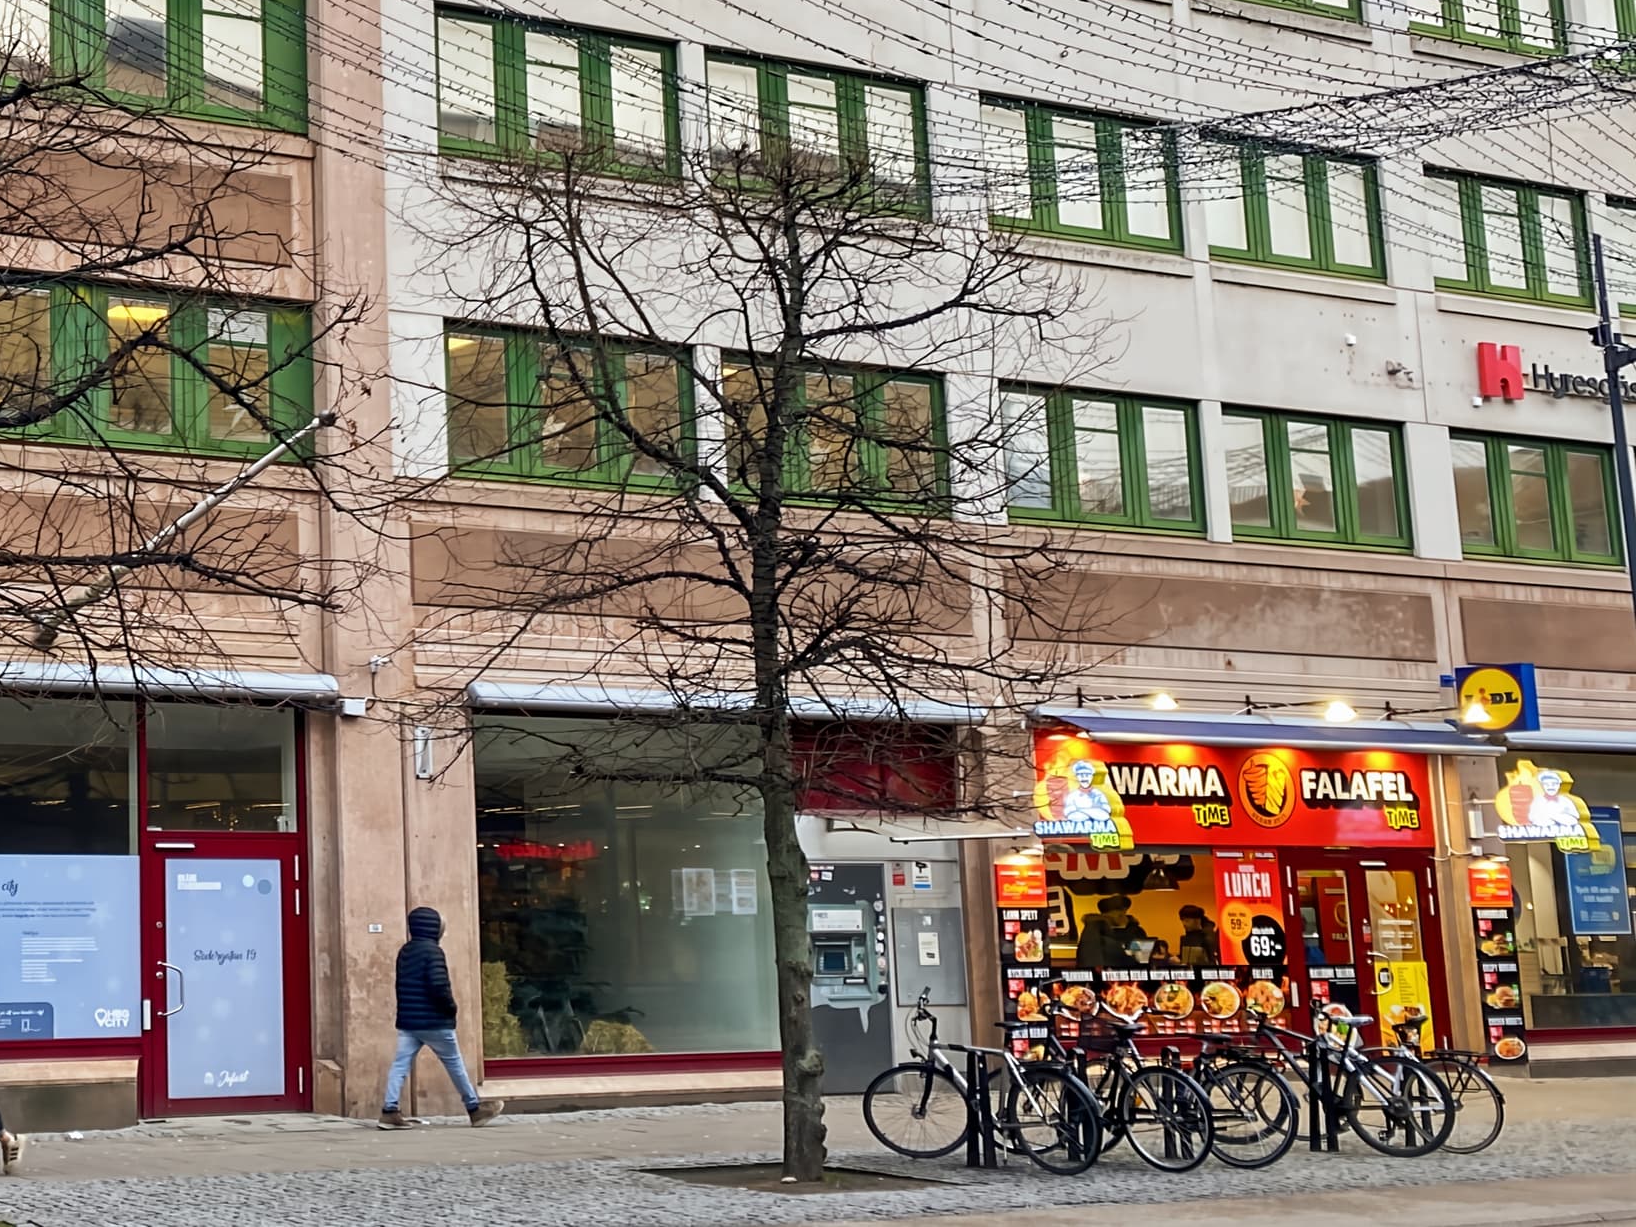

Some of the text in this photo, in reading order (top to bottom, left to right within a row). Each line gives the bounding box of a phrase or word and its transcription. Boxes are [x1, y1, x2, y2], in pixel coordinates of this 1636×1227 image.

[1106, 765, 1225, 798] WARMA
[1300, 770, 1414, 802] FALAFEL
[1195, 806, 1229, 826] TIME
[1387, 809, 1418, 828] TIME
[1034, 820, 1116, 835] SHAWARMA
[1497, 825, 1586, 839] SHAWARMA
[1092, 834, 1119, 847] TIME
[1, 879, 19, 897] city
[1224, 872, 1272, 898] LUNCH
[246, 948, 258, 961] 19
[1250, 935, 1282, 957] 69:-
[105, 1018, 130, 1029] CITY
